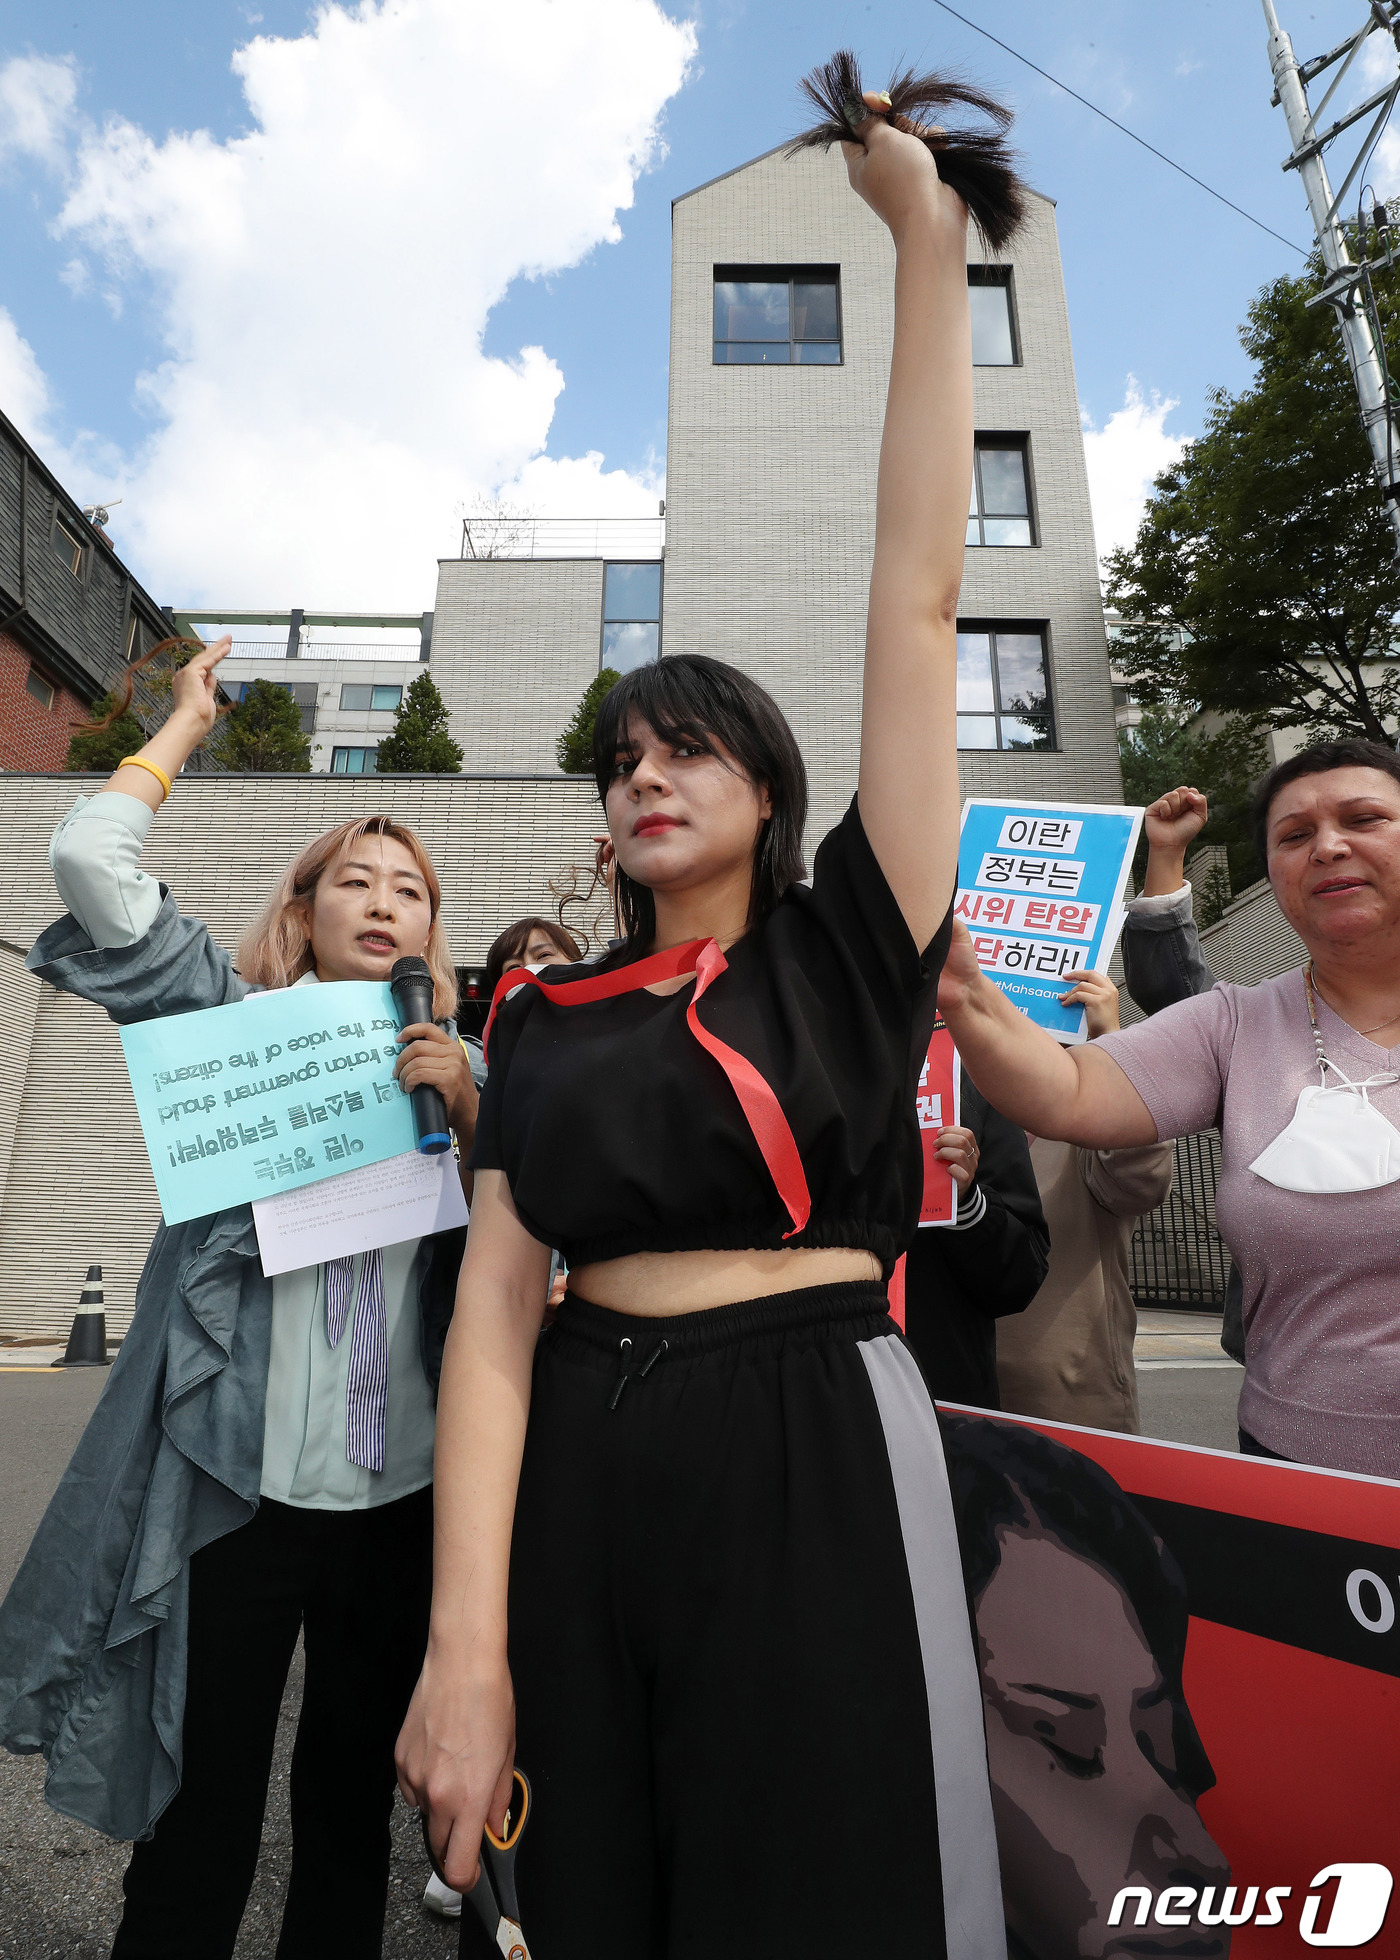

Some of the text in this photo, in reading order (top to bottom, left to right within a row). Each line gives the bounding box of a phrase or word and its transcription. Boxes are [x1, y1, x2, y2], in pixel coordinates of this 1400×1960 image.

[1008, 820, 1071, 848] 이란
[985, 856, 1078, 890] 정부는
[954, 894, 1093, 934] 시위 탄압
[974, 937, 1080, 976] 단하라!
[337, 1022, 366, 1039] the
[371, 1018, 400, 1034] fear
[228, 1050, 259, 1069] the
[264, 1043, 283, 1064] of
[324, 1048, 381, 1073] Iranian
[152, 1059, 224, 1094] citizens!
[223, 1061, 321, 1108] government
[157, 1094, 217, 1126] should
[287, 1090, 365, 1131] 목소리를
[253, 1146, 316, 1181] 정부는
[322, 1133, 364, 1163] 이란
